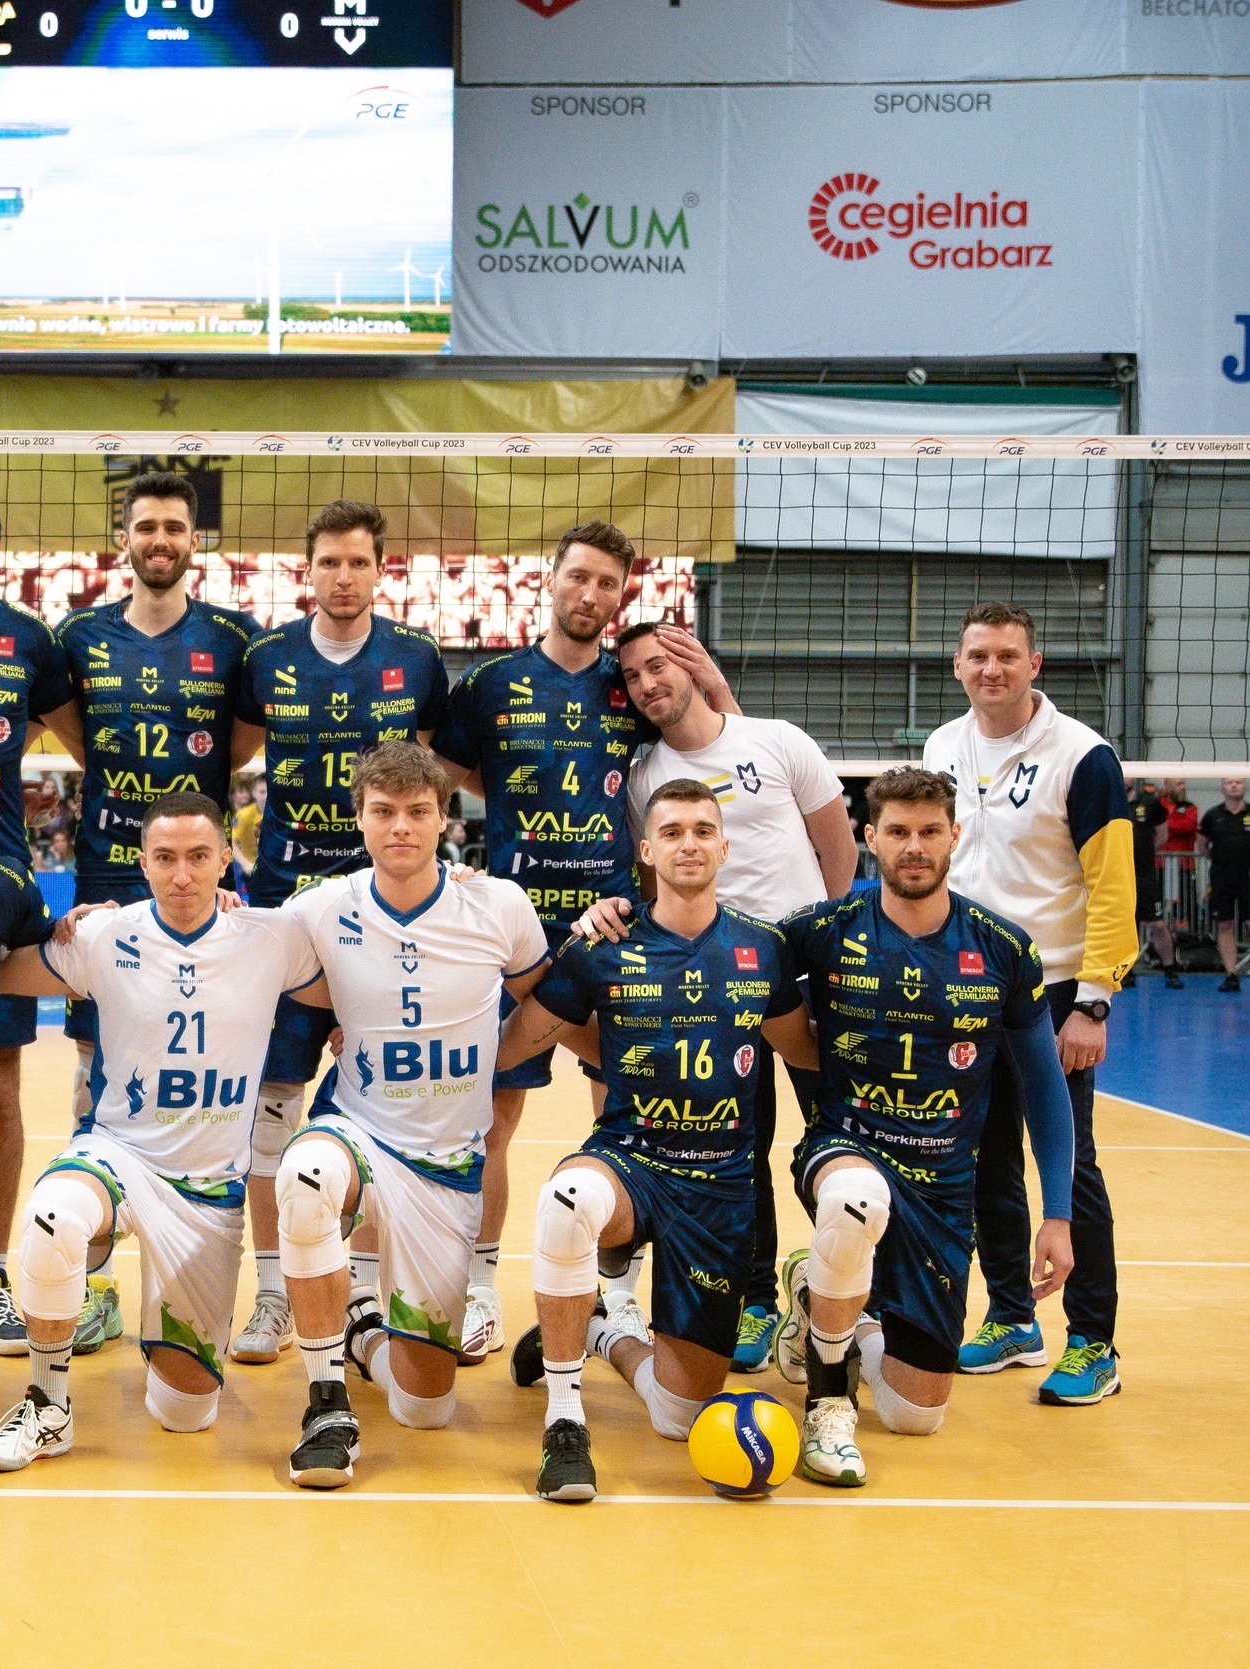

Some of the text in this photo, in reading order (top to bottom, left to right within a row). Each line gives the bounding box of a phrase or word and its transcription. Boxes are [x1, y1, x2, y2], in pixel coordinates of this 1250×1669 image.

[39, 11, 59, 38] 0
[280, 12, 299, 38] 0
[530, 96, 647, 117] SPONSOR
[874, 92, 991, 114] SPONSOR
[356, 103, 409, 119] PGE
[475, 202, 690, 250] SALVUM
[908, 239, 1053, 270] Grabarz
[478, 254, 686, 274] ODSZKODOWANIA
[208, 316, 264, 336] farmy
[11, 437, 31, 447] Cup
[32, 437, 55, 445] 2023
[95, 442, 121, 451] PGE
[177, 443, 203, 451] PGE
[259, 443, 285, 452] PGE
[352, 439, 465, 450] CEV Volleyball Cup 2023
[505, 444, 531, 453] PGE
[587, 445, 614, 454] PGE
[669, 445, 695, 454] PGE
[763, 441, 876, 452] CEV Volleyball Cup 2023
[1176, 442, 1244, 453] CEV Volleyball
[917, 446, 943, 455] PGE
[999, 446, 1025, 455] PGE
[1082, 446, 1108, 456] PGE
[89, 660, 109, 668] nine
[91, 676, 122, 687] TIRONI
[274, 686, 296, 695] nine
[510, 697, 533, 705] nine
[274, 705, 310, 717] TIRONI
[510, 712, 546, 724] TIRONI
[134, 722, 170, 758] 12
[322, 752, 357, 788] 15
[103, 768, 201, 793] VALSA
[562, 760, 580, 796] 4
[517, 810, 613, 833] VALSA
[536, 832, 597, 843] GROUP
[543, 858, 614, 869] PerkinElmer
[339, 935, 362, 945] nine
[116, 959, 140, 970] nine
[840, 955, 866, 966] nine
[621, 965, 646, 975] nine
[840, 973, 879, 990] TIRONI
[620, 984, 662, 998] TIRONI
[402, 986, 422, 1028] 5
[953, 1013, 988, 1032] VEM
[167, 1011, 205, 1054] 21
[674, 1038, 713, 1080] 16
[898, 1032, 913, 1071] 1
[383, 1039, 478, 1082] Blu
[156, 1068, 248, 1109] Blu
[383, 1078, 478, 1098] Gas e Power
[850, 1078, 960, 1110] VALSA
[632, 1093, 739, 1121] VALSA
[869, 1101, 938, 1120] GROUP
[155, 1108, 242, 1125] Gas e Power
[652, 1119, 721, 1132] GROUP
[874, 1130, 956, 1147] PerkinElmer
[656, 1146, 735, 1160] PerkinElmer
